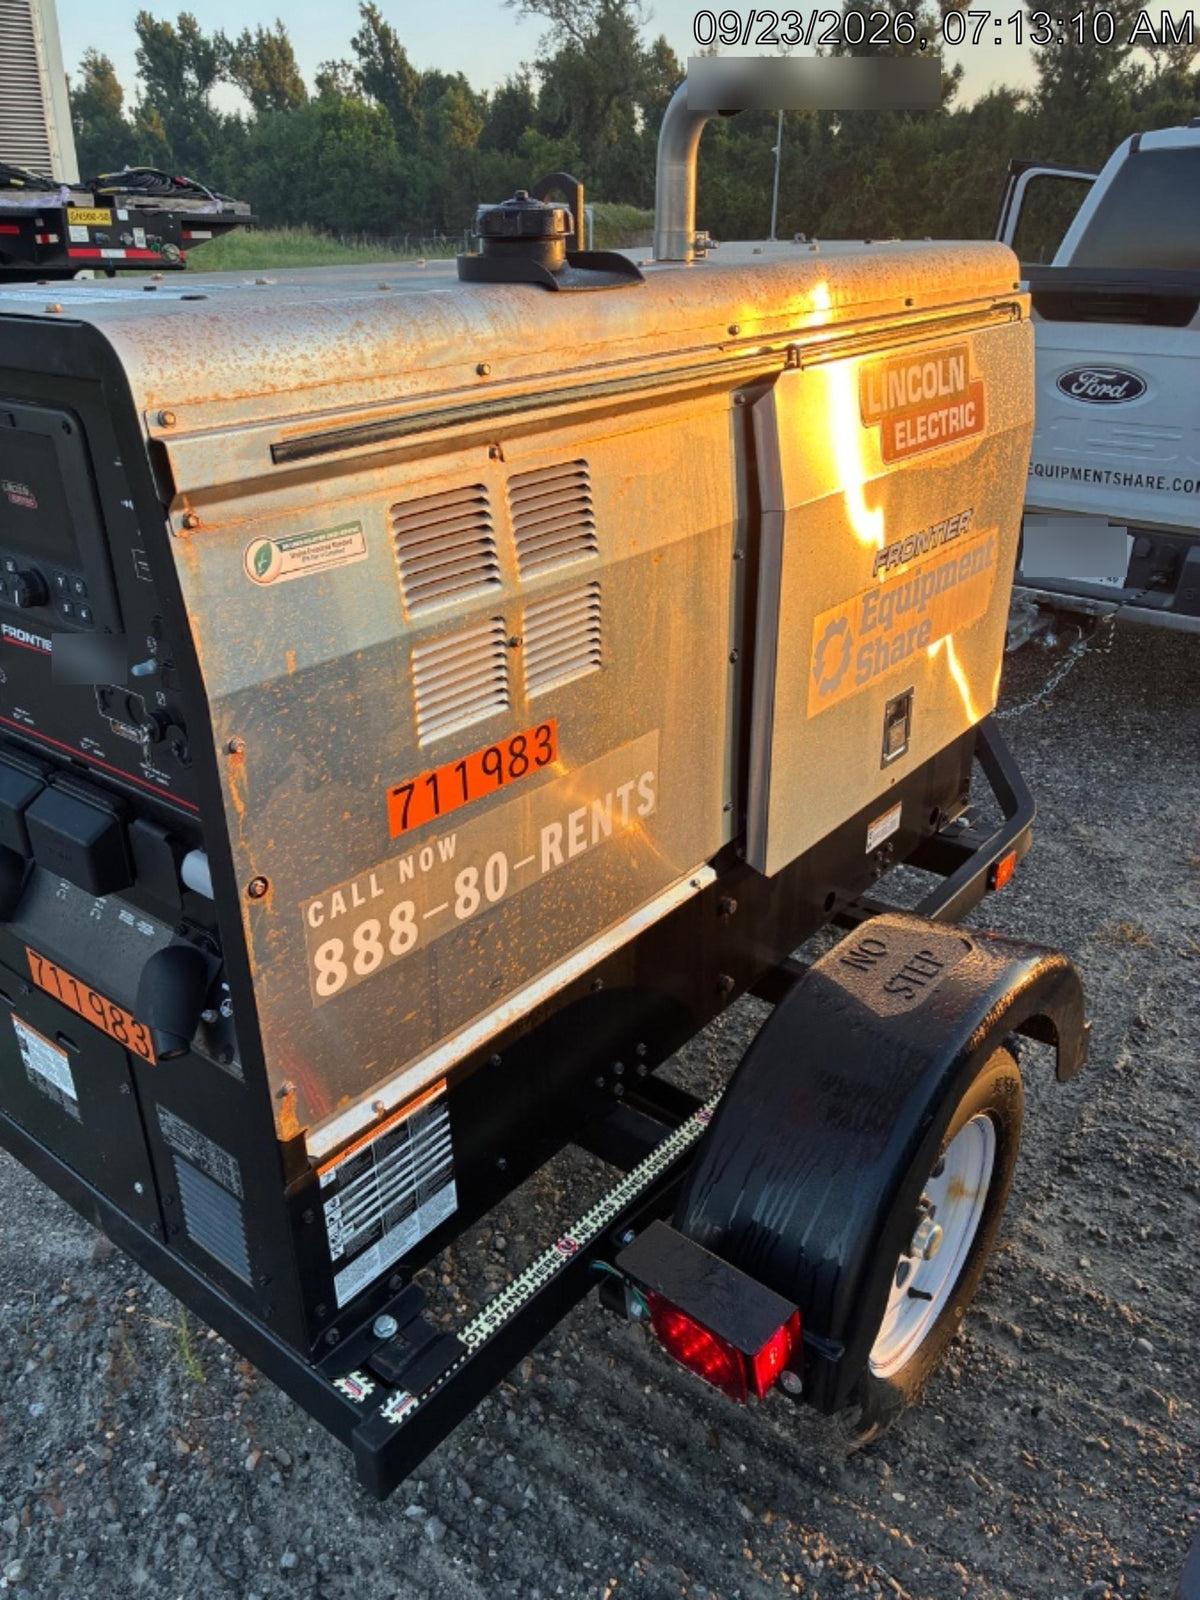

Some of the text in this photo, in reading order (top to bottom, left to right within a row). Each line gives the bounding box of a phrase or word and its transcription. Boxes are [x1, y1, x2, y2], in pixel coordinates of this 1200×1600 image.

[866, 355, 966, 415] LINCOLN
[1071, 369, 1130, 399] Ford
[894, 401, 976, 451] ELECTRIC
[872, 508, 974, 578] FRONTIER
[858, 538, 995, 636] Equipment
[1, 623, 52, 651] FRONTIE
[855, 618, 933, 687] Share
[392, 724, 552, 830] 711983
[307, 833, 457, 928] CALL NOW
[313, 771, 656, 997] 888-80-RENTS
[840, 938, 887, 972] NO
[883, 950, 945, 1001] STEP
[30, 950, 150, 1058] 711983
[464, 1325, 484, 1344] OT
[484, 1283, 529, 1325] STAND
[531, 1251, 563, 1281] HERE
[574, 1223, 591, 1240] NE
[590, 1202, 615, 1223] PAS
